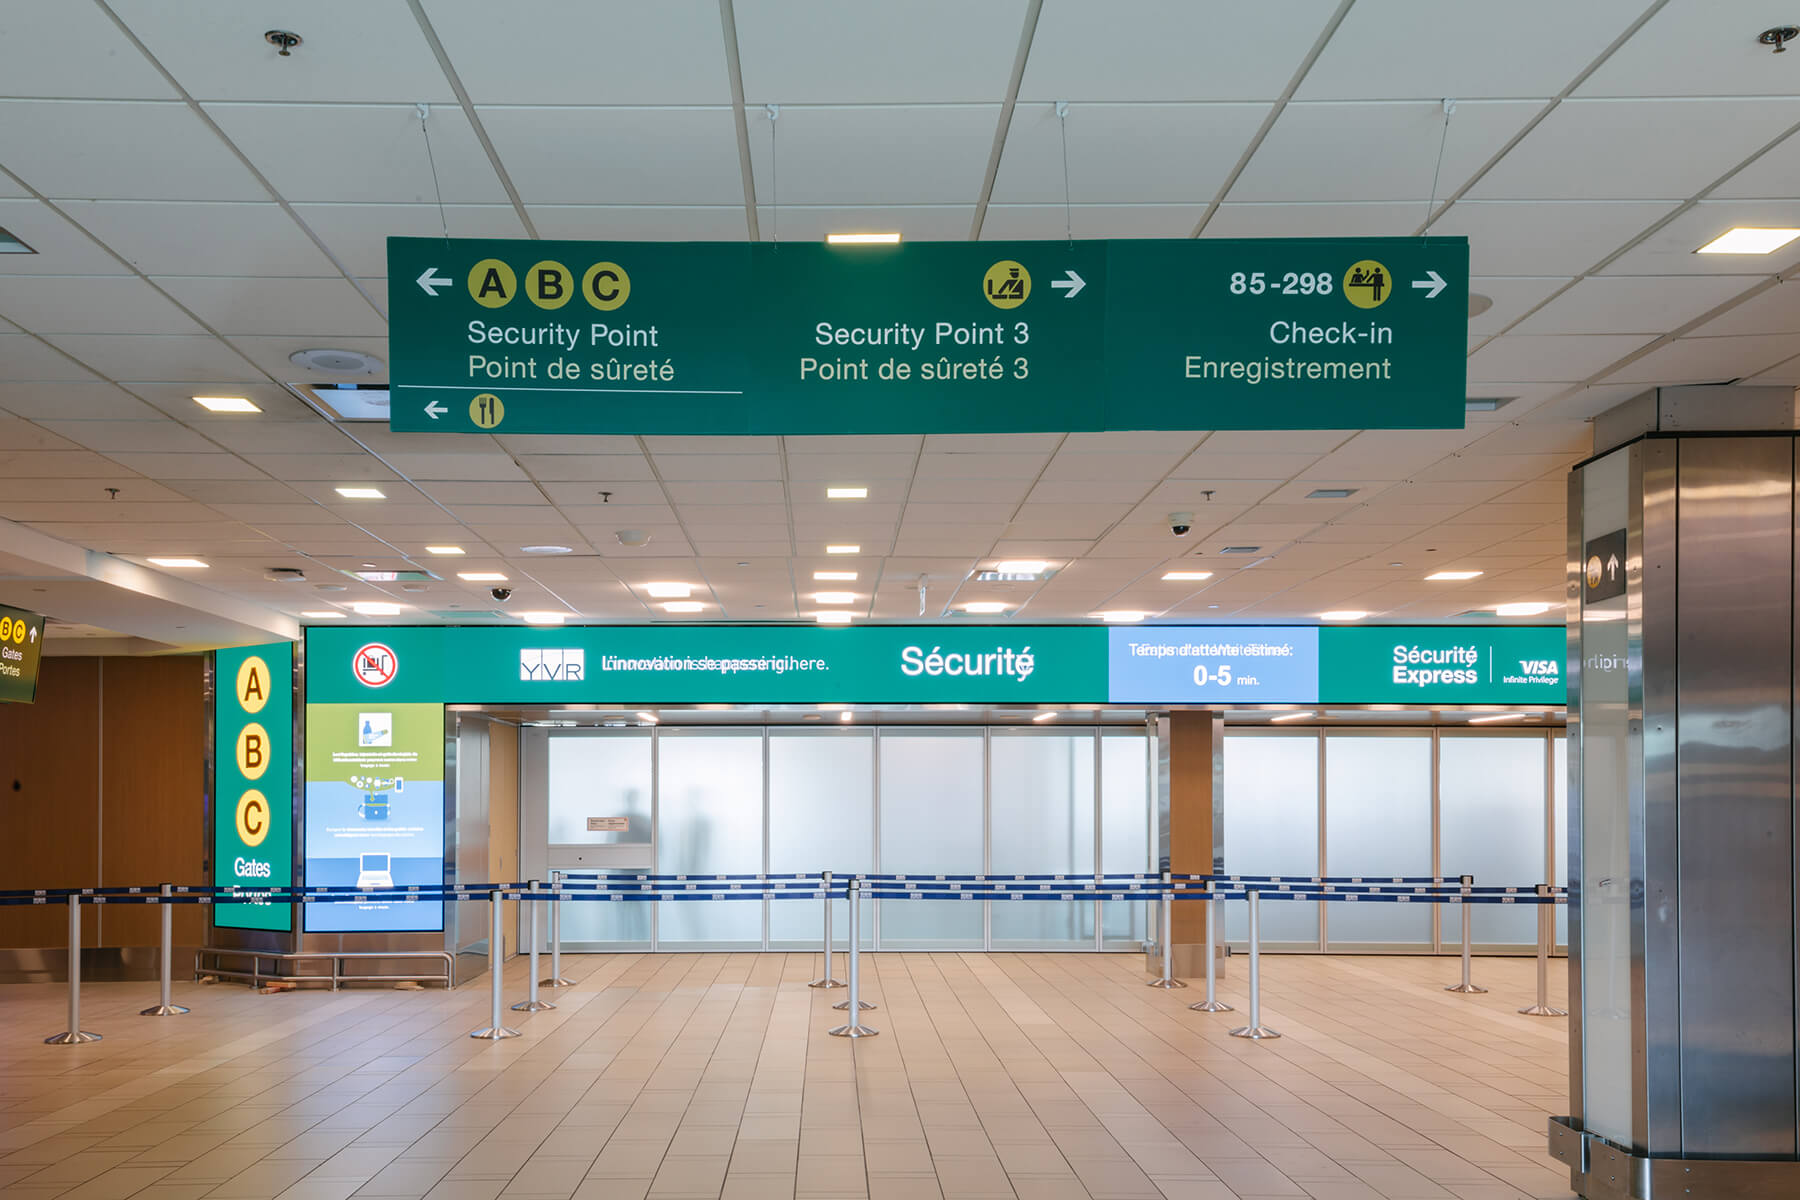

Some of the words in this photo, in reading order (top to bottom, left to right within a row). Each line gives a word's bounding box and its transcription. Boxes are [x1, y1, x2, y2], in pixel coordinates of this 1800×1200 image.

[478, 267, 507, 299] A
[538, 269, 563, 300] B
[592, 270, 620, 302] C
[1229, 272, 1333, 296] 85-298
[468, 320, 581, 351] Security
[591, 323, 659, 347] Point
[815, 322, 925, 351] Security
[935, 322, 1005, 345] Point
[1013, 322, 1030, 345] 3
[1270, 320, 1393, 345] Check-in
[469, 355, 537, 379] Point
[547, 356, 581, 380] de
[590, 357, 675, 382] sûreté
[800, 357, 869, 380] Point
[878, 357, 912, 380] de
[920, 356, 1004, 380] sûreté
[1013, 357, 1030, 380] 3
[1185, 355, 1392, 385] Enregistrement
[2, 621, 10, 636] B
[15, 624, 23, 638] C
[2, 646, 23, 661] Gates
[0, 662, 20, 677] Portes
[521, 662, 582, 681] YVR
[1193, 664, 1232, 687] 0-5
[1236, 675, 1260, 686] min.
[1392, 665, 1478, 688] Express
[1519, 660, 1560, 675] VISA
[244, 667, 263, 701] A
[1503, 675, 1528, 685] Infinite
[1529, 675, 1560, 686] Privilege
[245, 735, 262, 769] B
[244, 800, 262, 836] C
[234, 856, 271, 878] Gates
